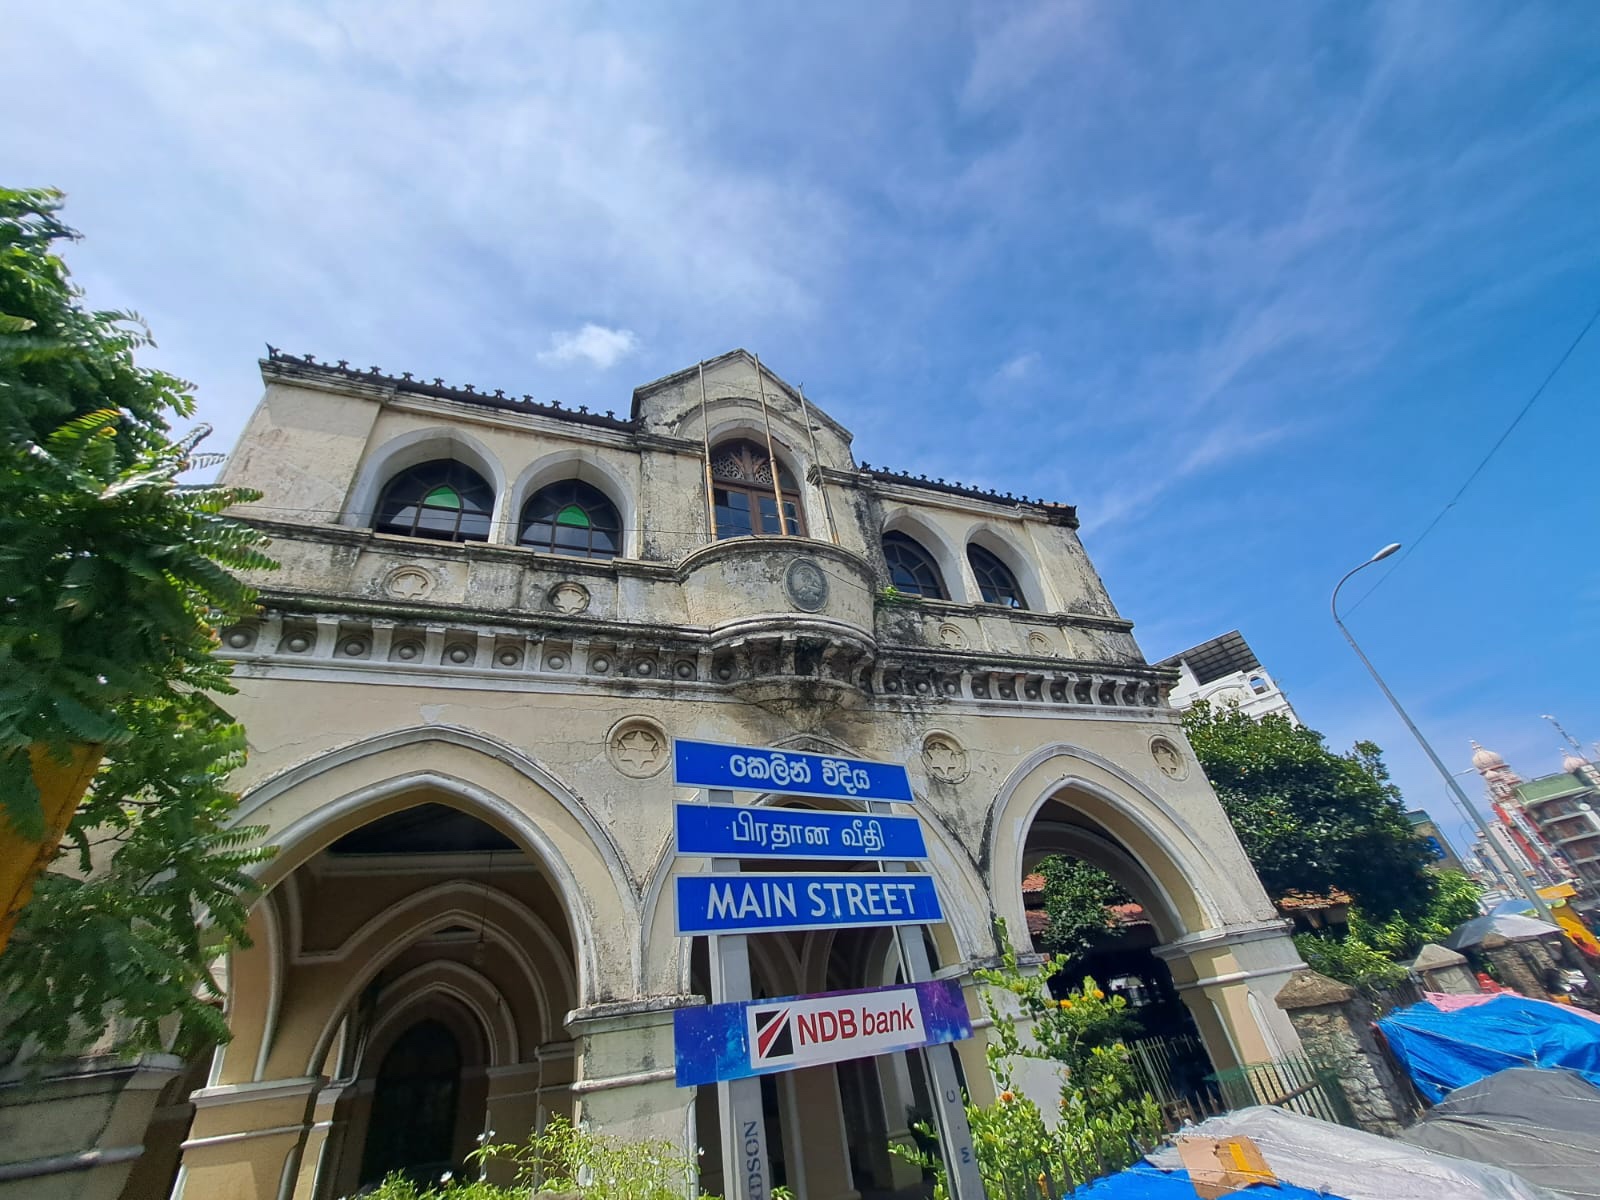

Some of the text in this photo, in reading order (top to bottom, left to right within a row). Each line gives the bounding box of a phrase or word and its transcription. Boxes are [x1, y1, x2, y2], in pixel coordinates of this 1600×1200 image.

[821, 759, 871, 795] වීදිය
[732, 810, 886, 853] பிரதான வீதி
[706, 882, 916, 920] MAIN STREET
[797, 1002, 915, 1046] NDB bank
